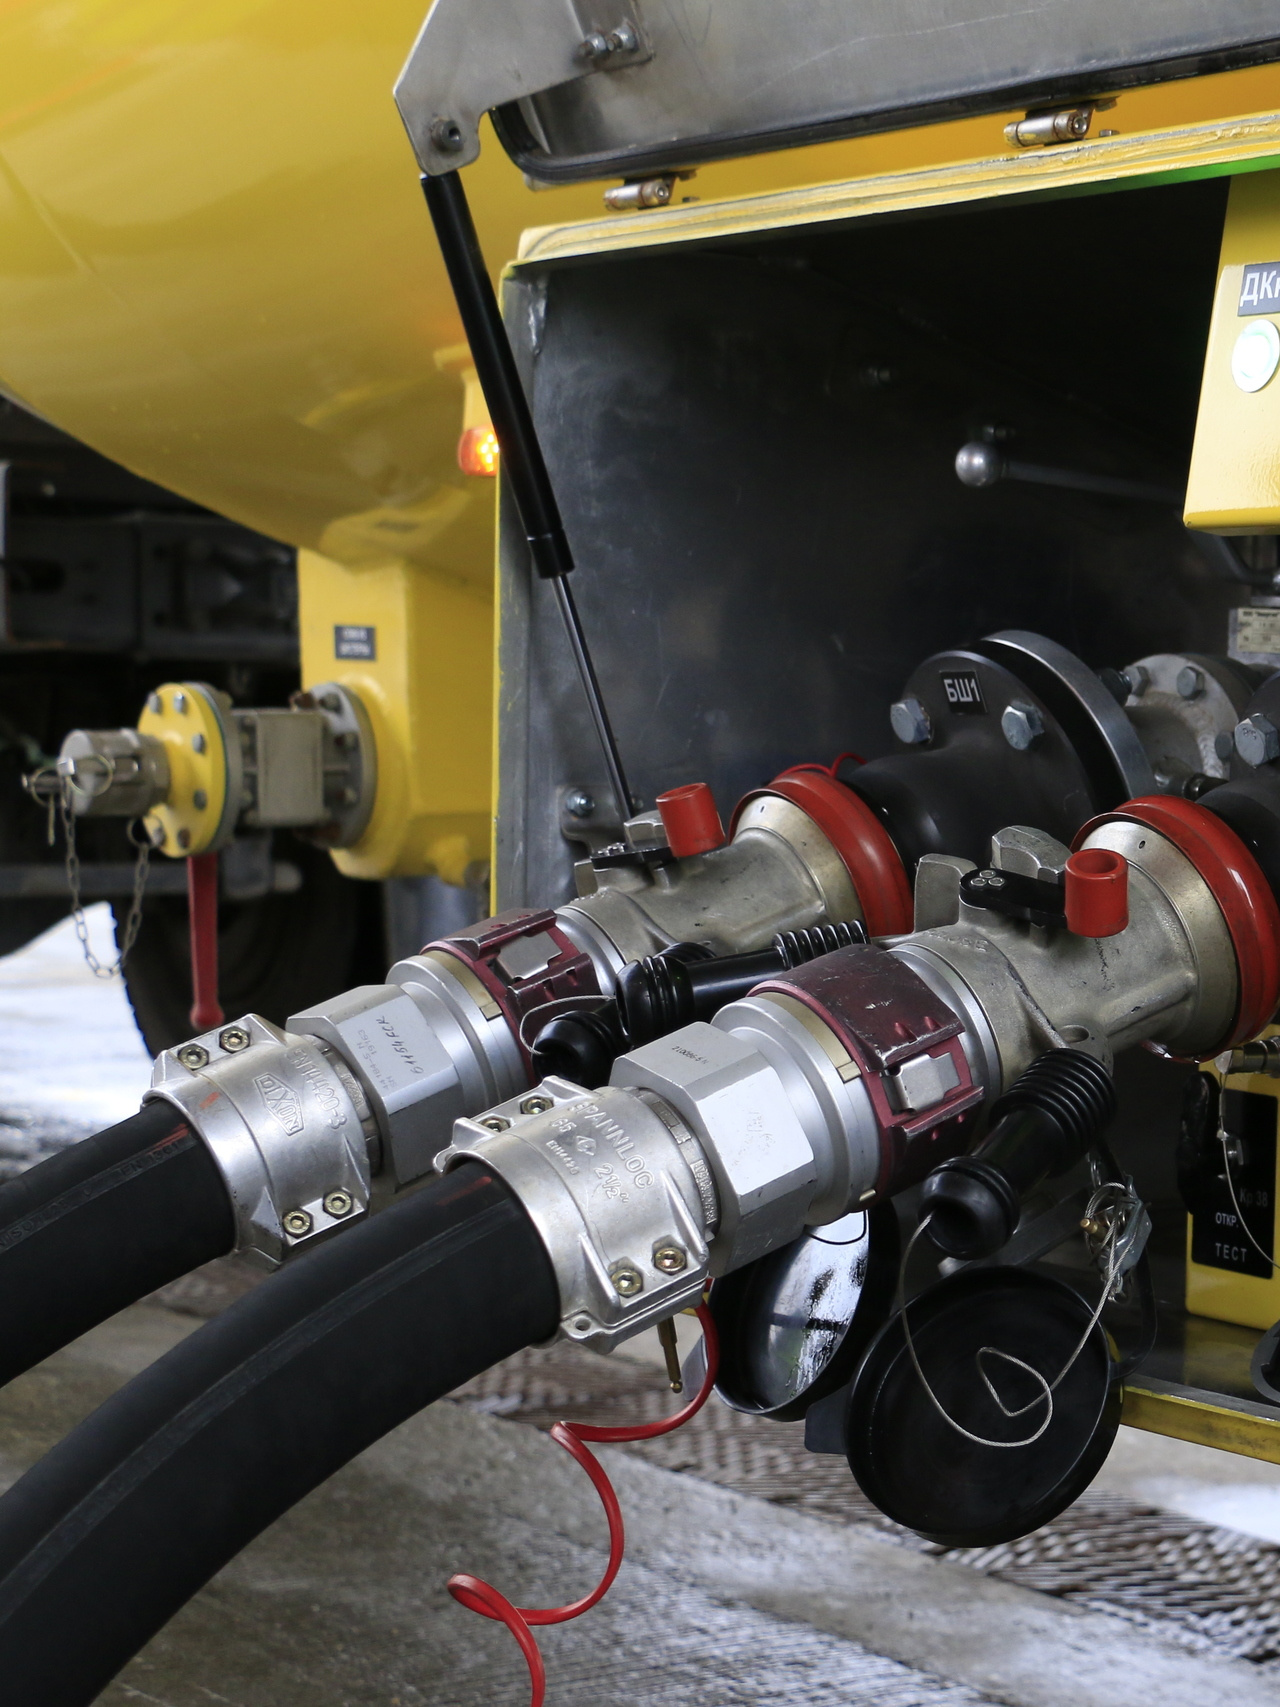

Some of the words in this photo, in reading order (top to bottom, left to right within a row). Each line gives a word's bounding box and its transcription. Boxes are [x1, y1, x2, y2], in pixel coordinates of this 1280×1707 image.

[944, 678, 981, 703] БШ1
[260, 1077, 299, 1131] DIXON
[567, 1102, 655, 1190] SPANNLOC
[1256, 1190, 1268, 1208] 38
[1215, 1212, 1239, 1228] ОТКР.
[1215, 1242, 1248, 1263] ТЕСТ
